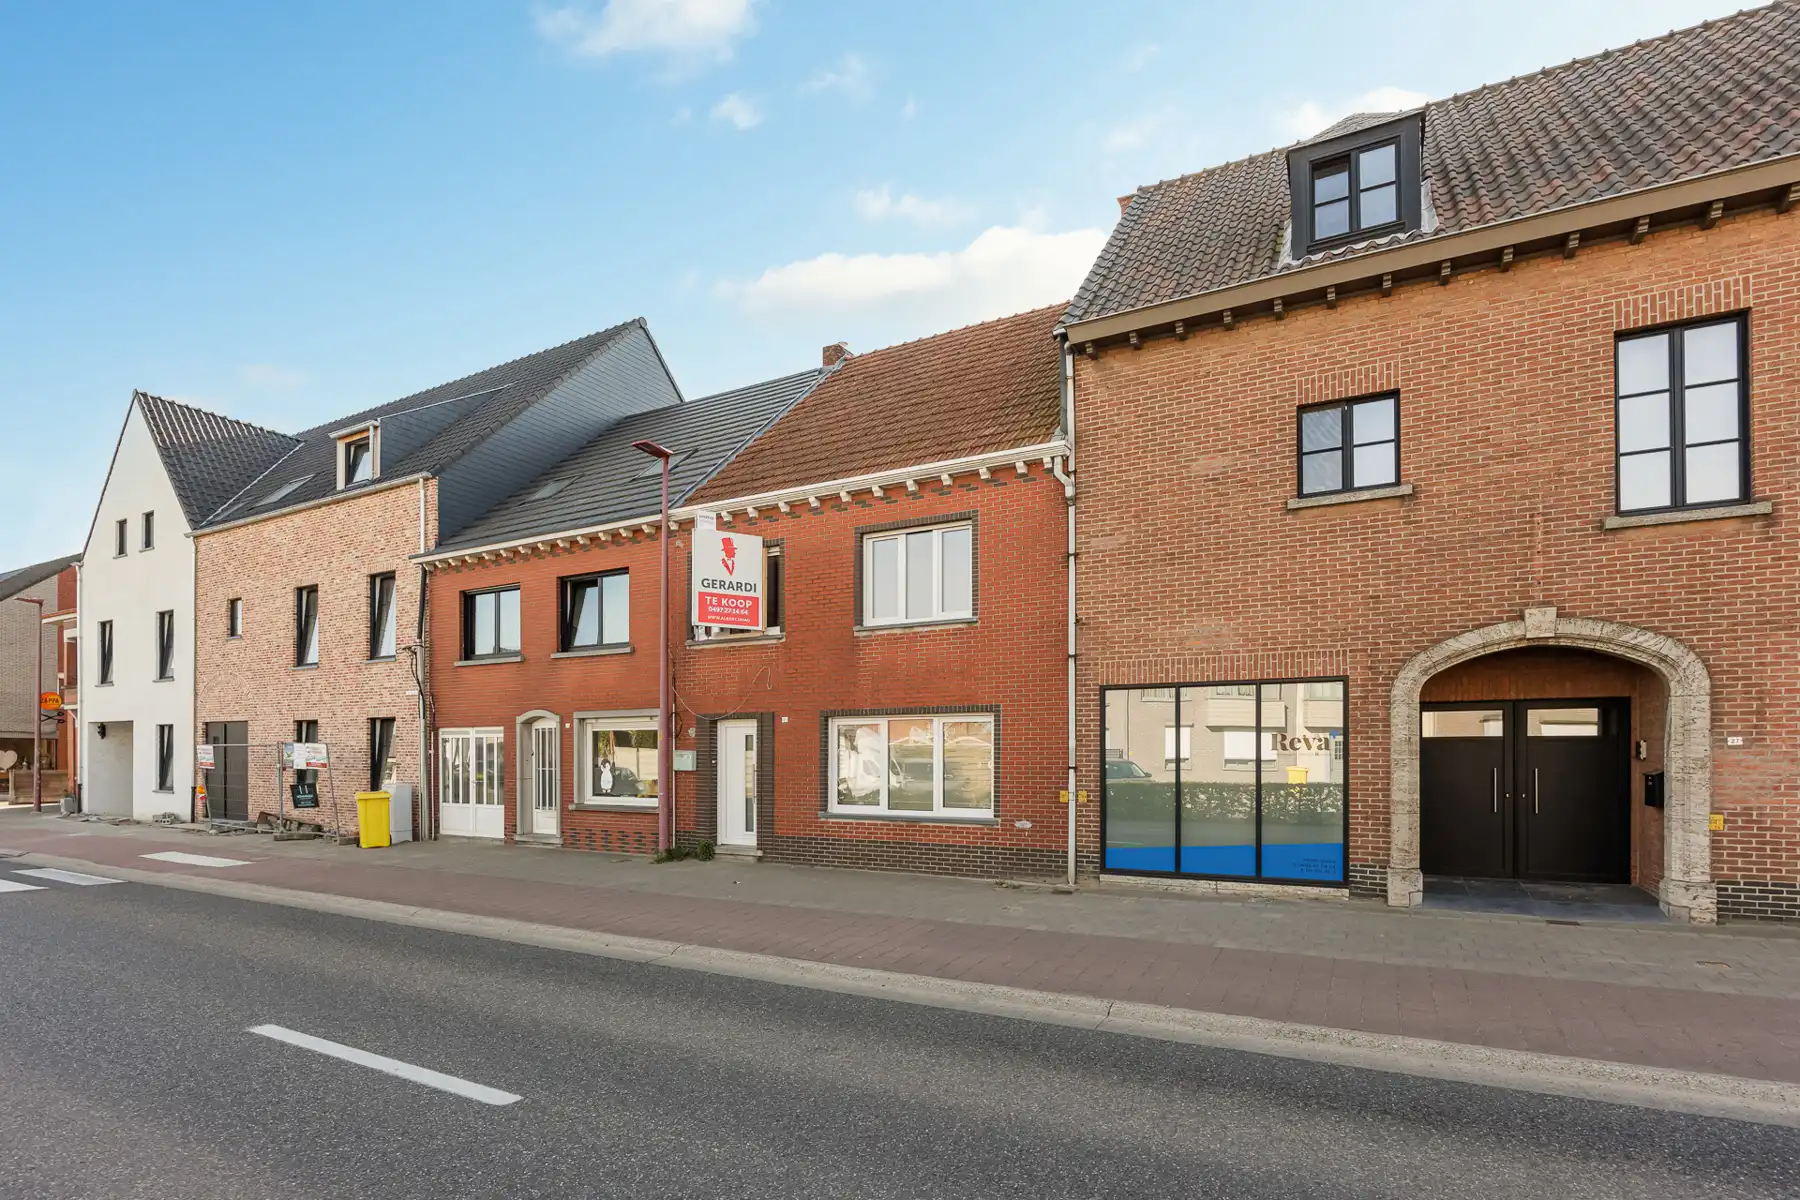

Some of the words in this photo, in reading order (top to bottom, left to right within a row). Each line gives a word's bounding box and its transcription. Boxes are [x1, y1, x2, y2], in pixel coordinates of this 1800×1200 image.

[701, 578, 757, 593] GERARDI
[705, 596, 718, 606] TE
[721, 597, 753, 609] KOOP
[1271, 733, 1331, 751] Reva
